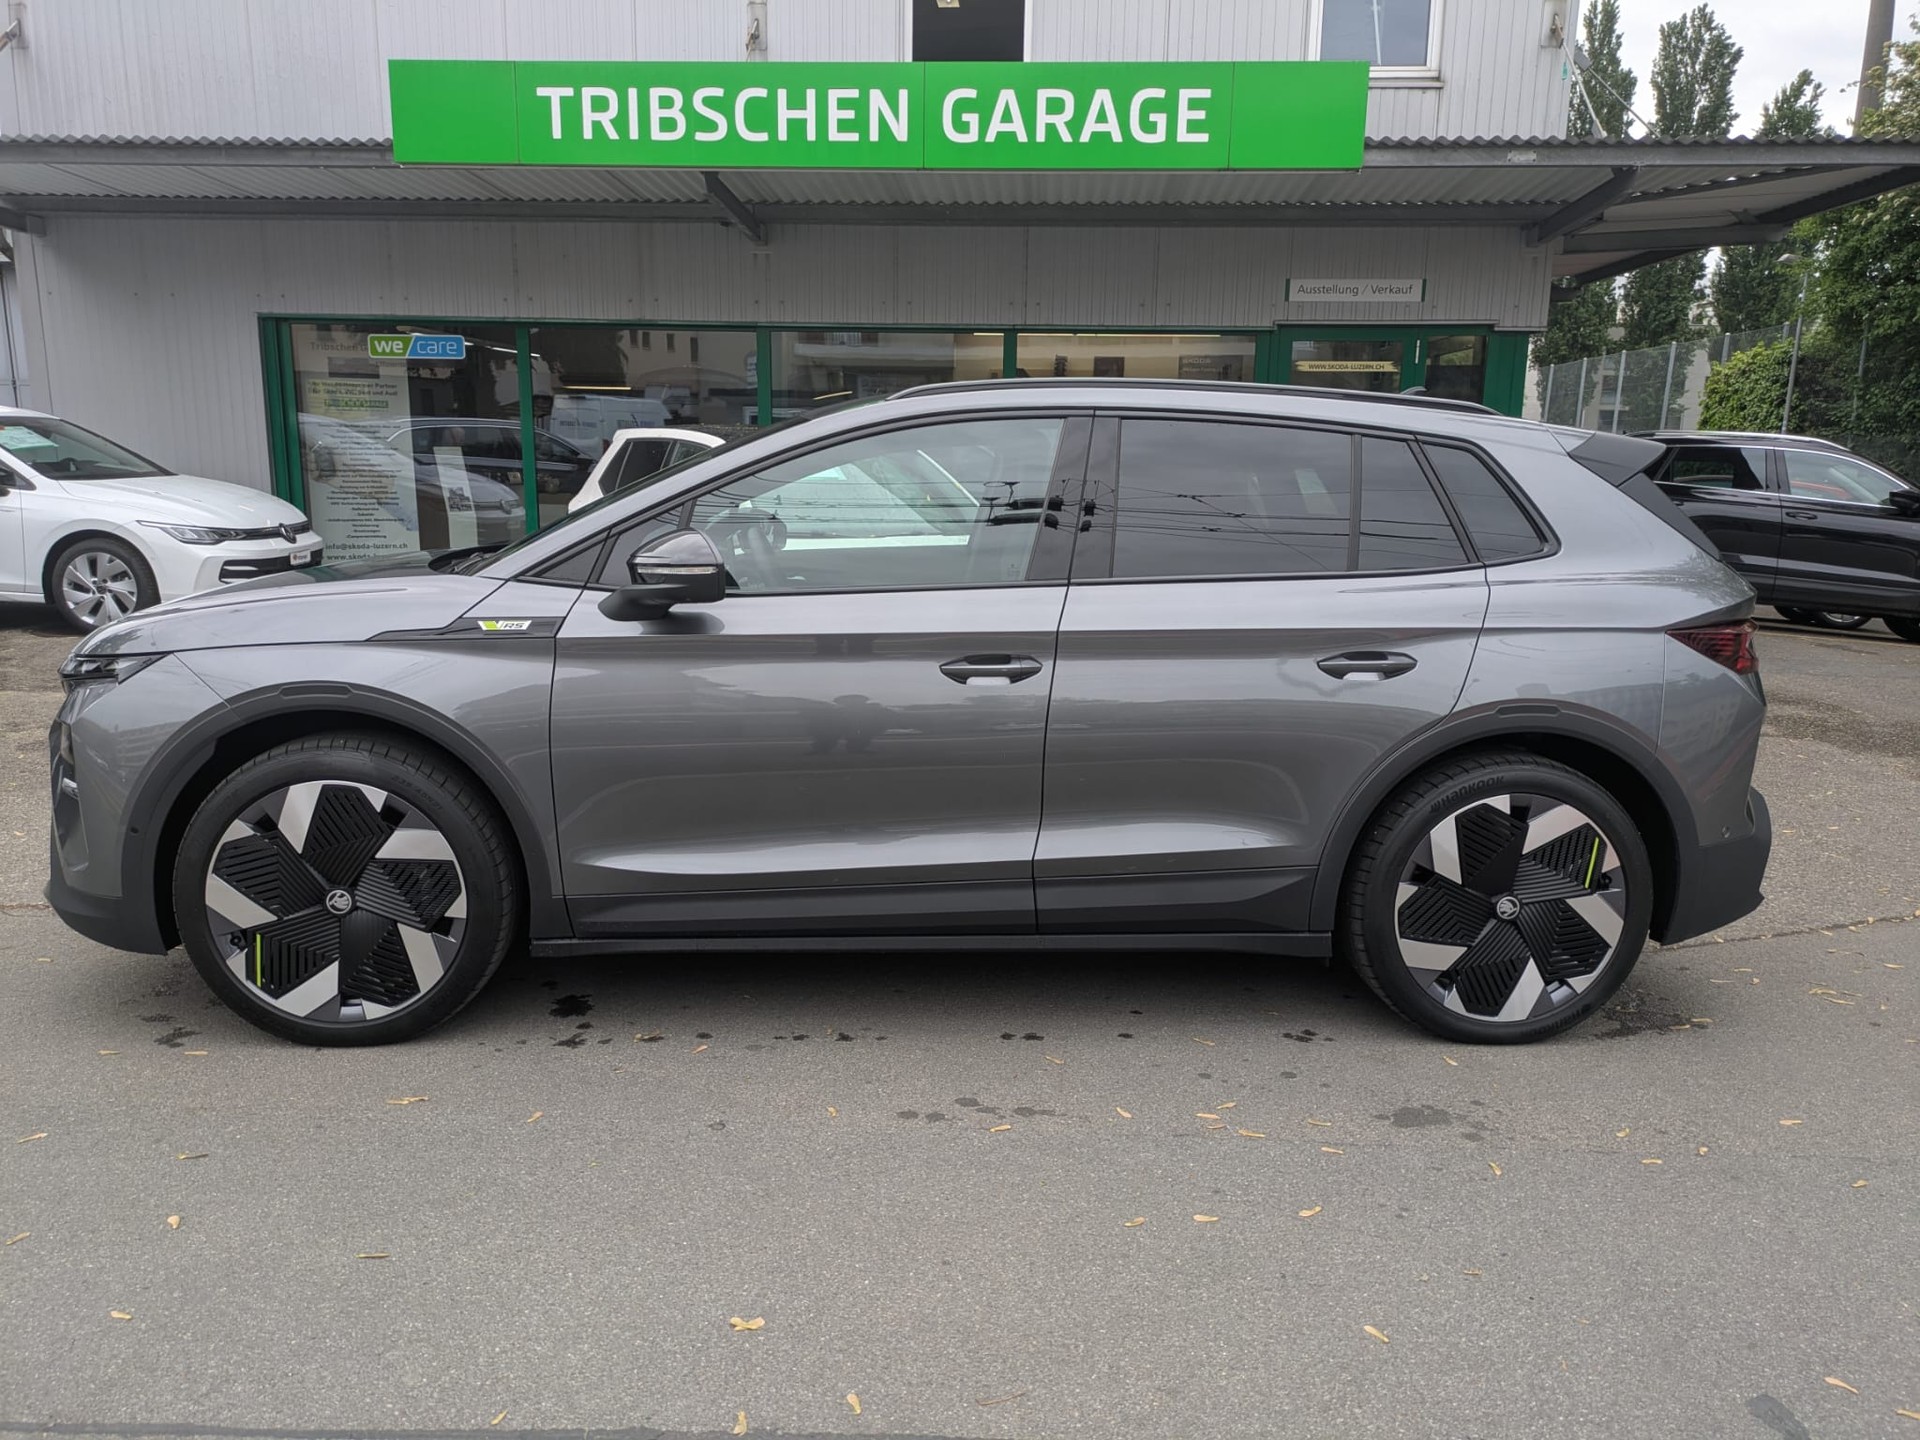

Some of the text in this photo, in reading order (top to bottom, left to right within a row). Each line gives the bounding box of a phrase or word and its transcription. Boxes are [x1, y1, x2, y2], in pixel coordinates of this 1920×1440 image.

[535, 86, 1212, 144] TRIBSCHEN GARAGE
[1297, 284, 1359, 297] Ausstellung
[1371, 284, 1414, 295] Verkauf
[373, 340, 404, 353] we
[416, 340, 458, 354] care
